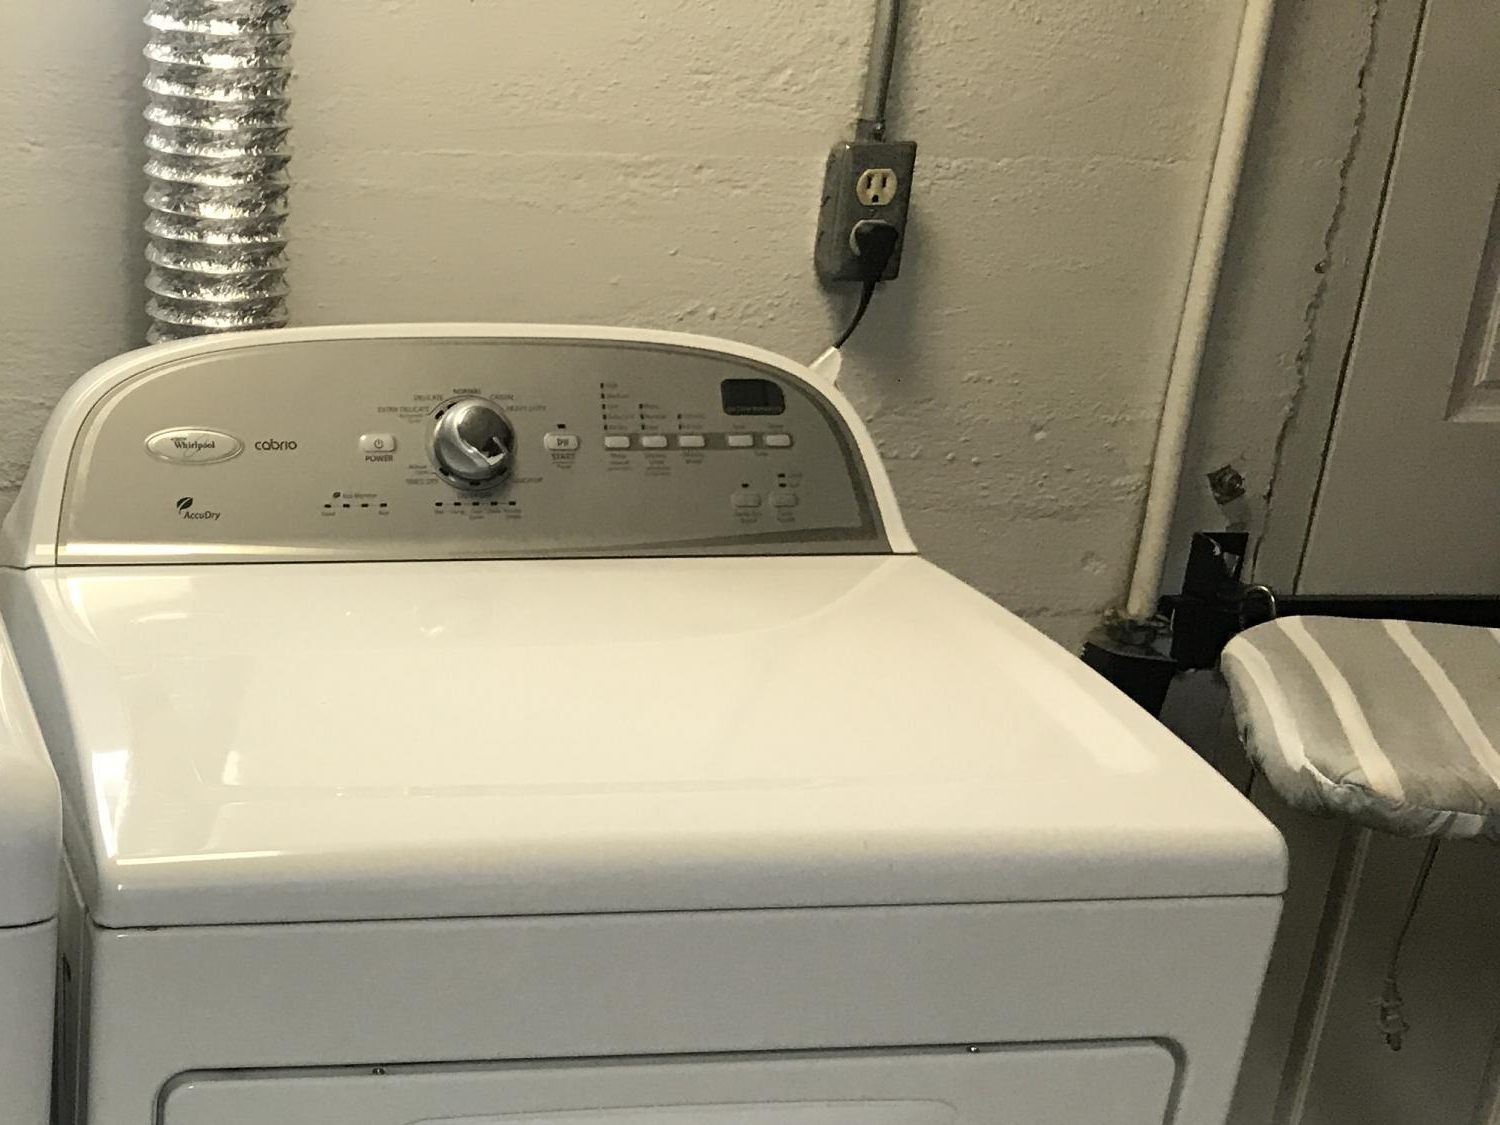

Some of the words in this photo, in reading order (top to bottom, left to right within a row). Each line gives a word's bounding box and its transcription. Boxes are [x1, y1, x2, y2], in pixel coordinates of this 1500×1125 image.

[174, 440, 216, 451] Whirlpool
[254, 439, 297, 451] cabrio
[365, 454, 394, 462] POWER
[184, 511, 221, 521] AccuDry
